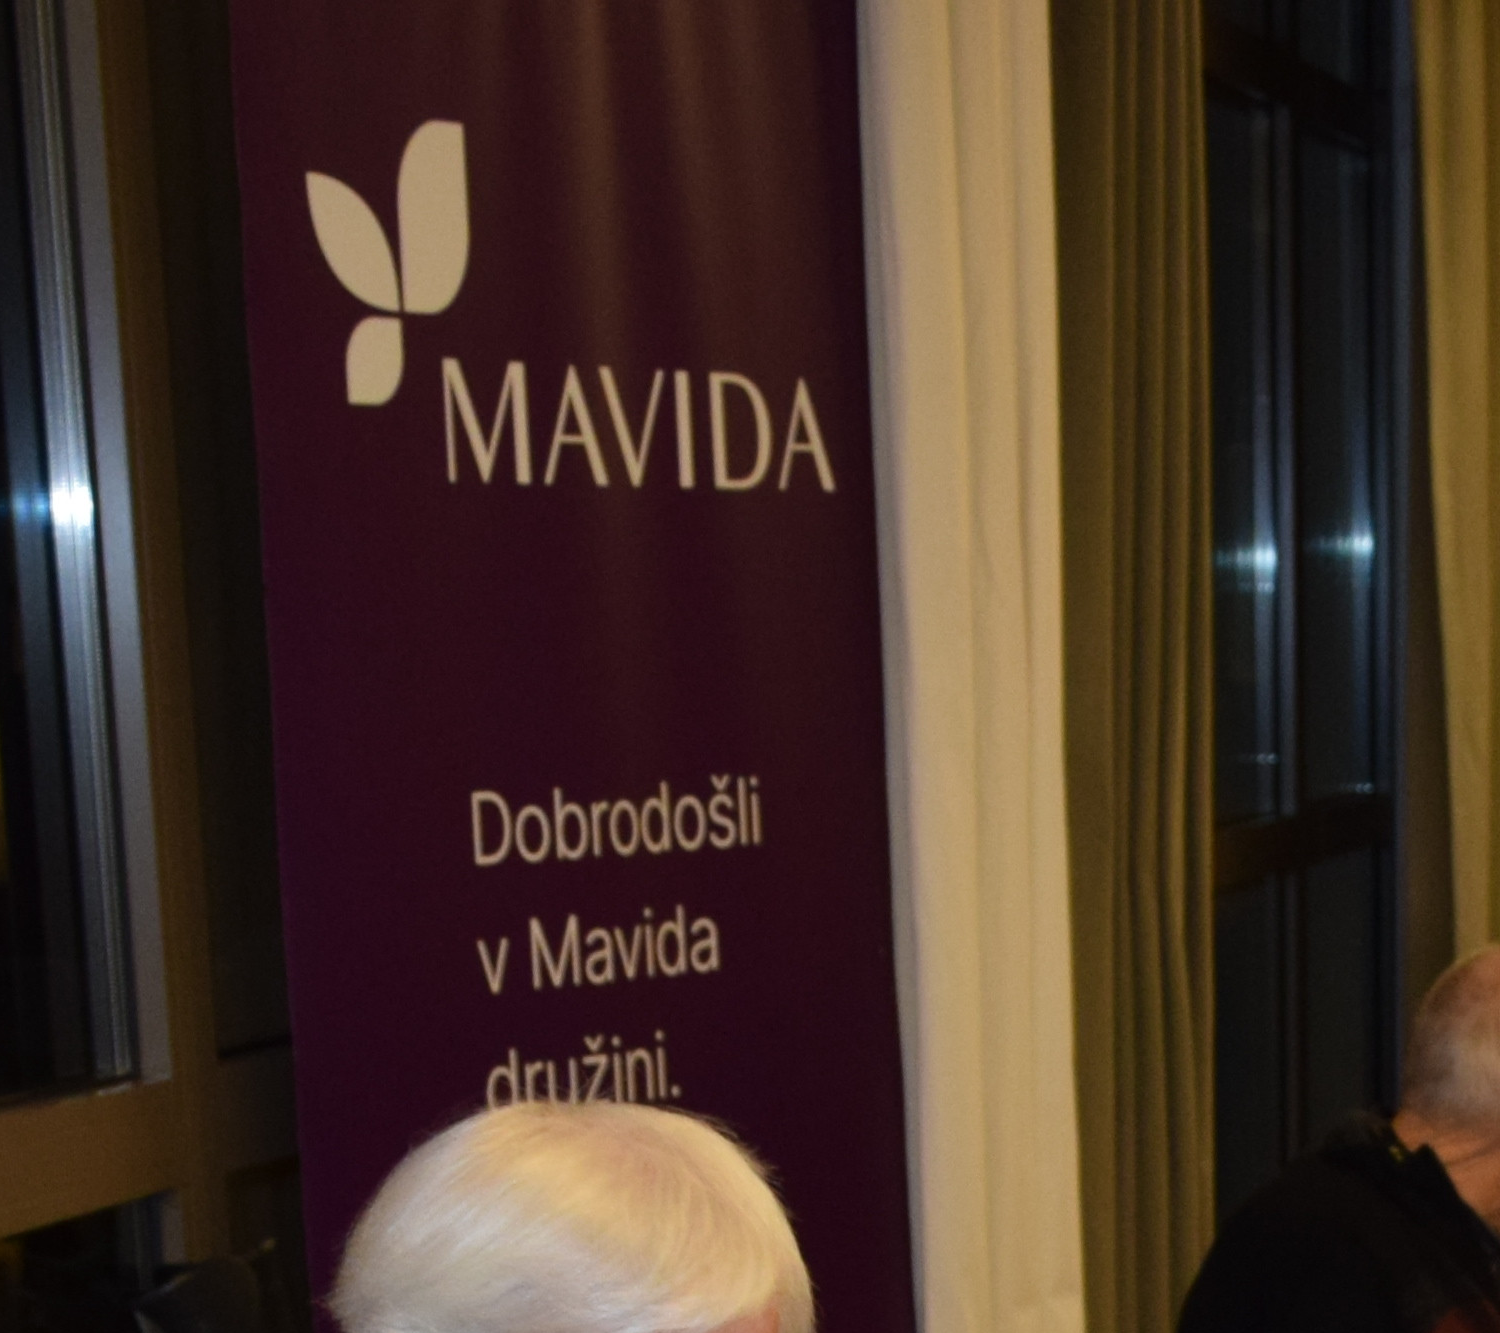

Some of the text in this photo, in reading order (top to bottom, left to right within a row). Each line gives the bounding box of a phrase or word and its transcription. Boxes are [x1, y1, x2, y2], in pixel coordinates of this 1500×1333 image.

[441, 356, 837, 494] MAVIDA
[469, 774, 763, 867] Dobrodošli
[476, 904, 721, 995] v Mavida
[486, 1028, 683, 1108] družini.
